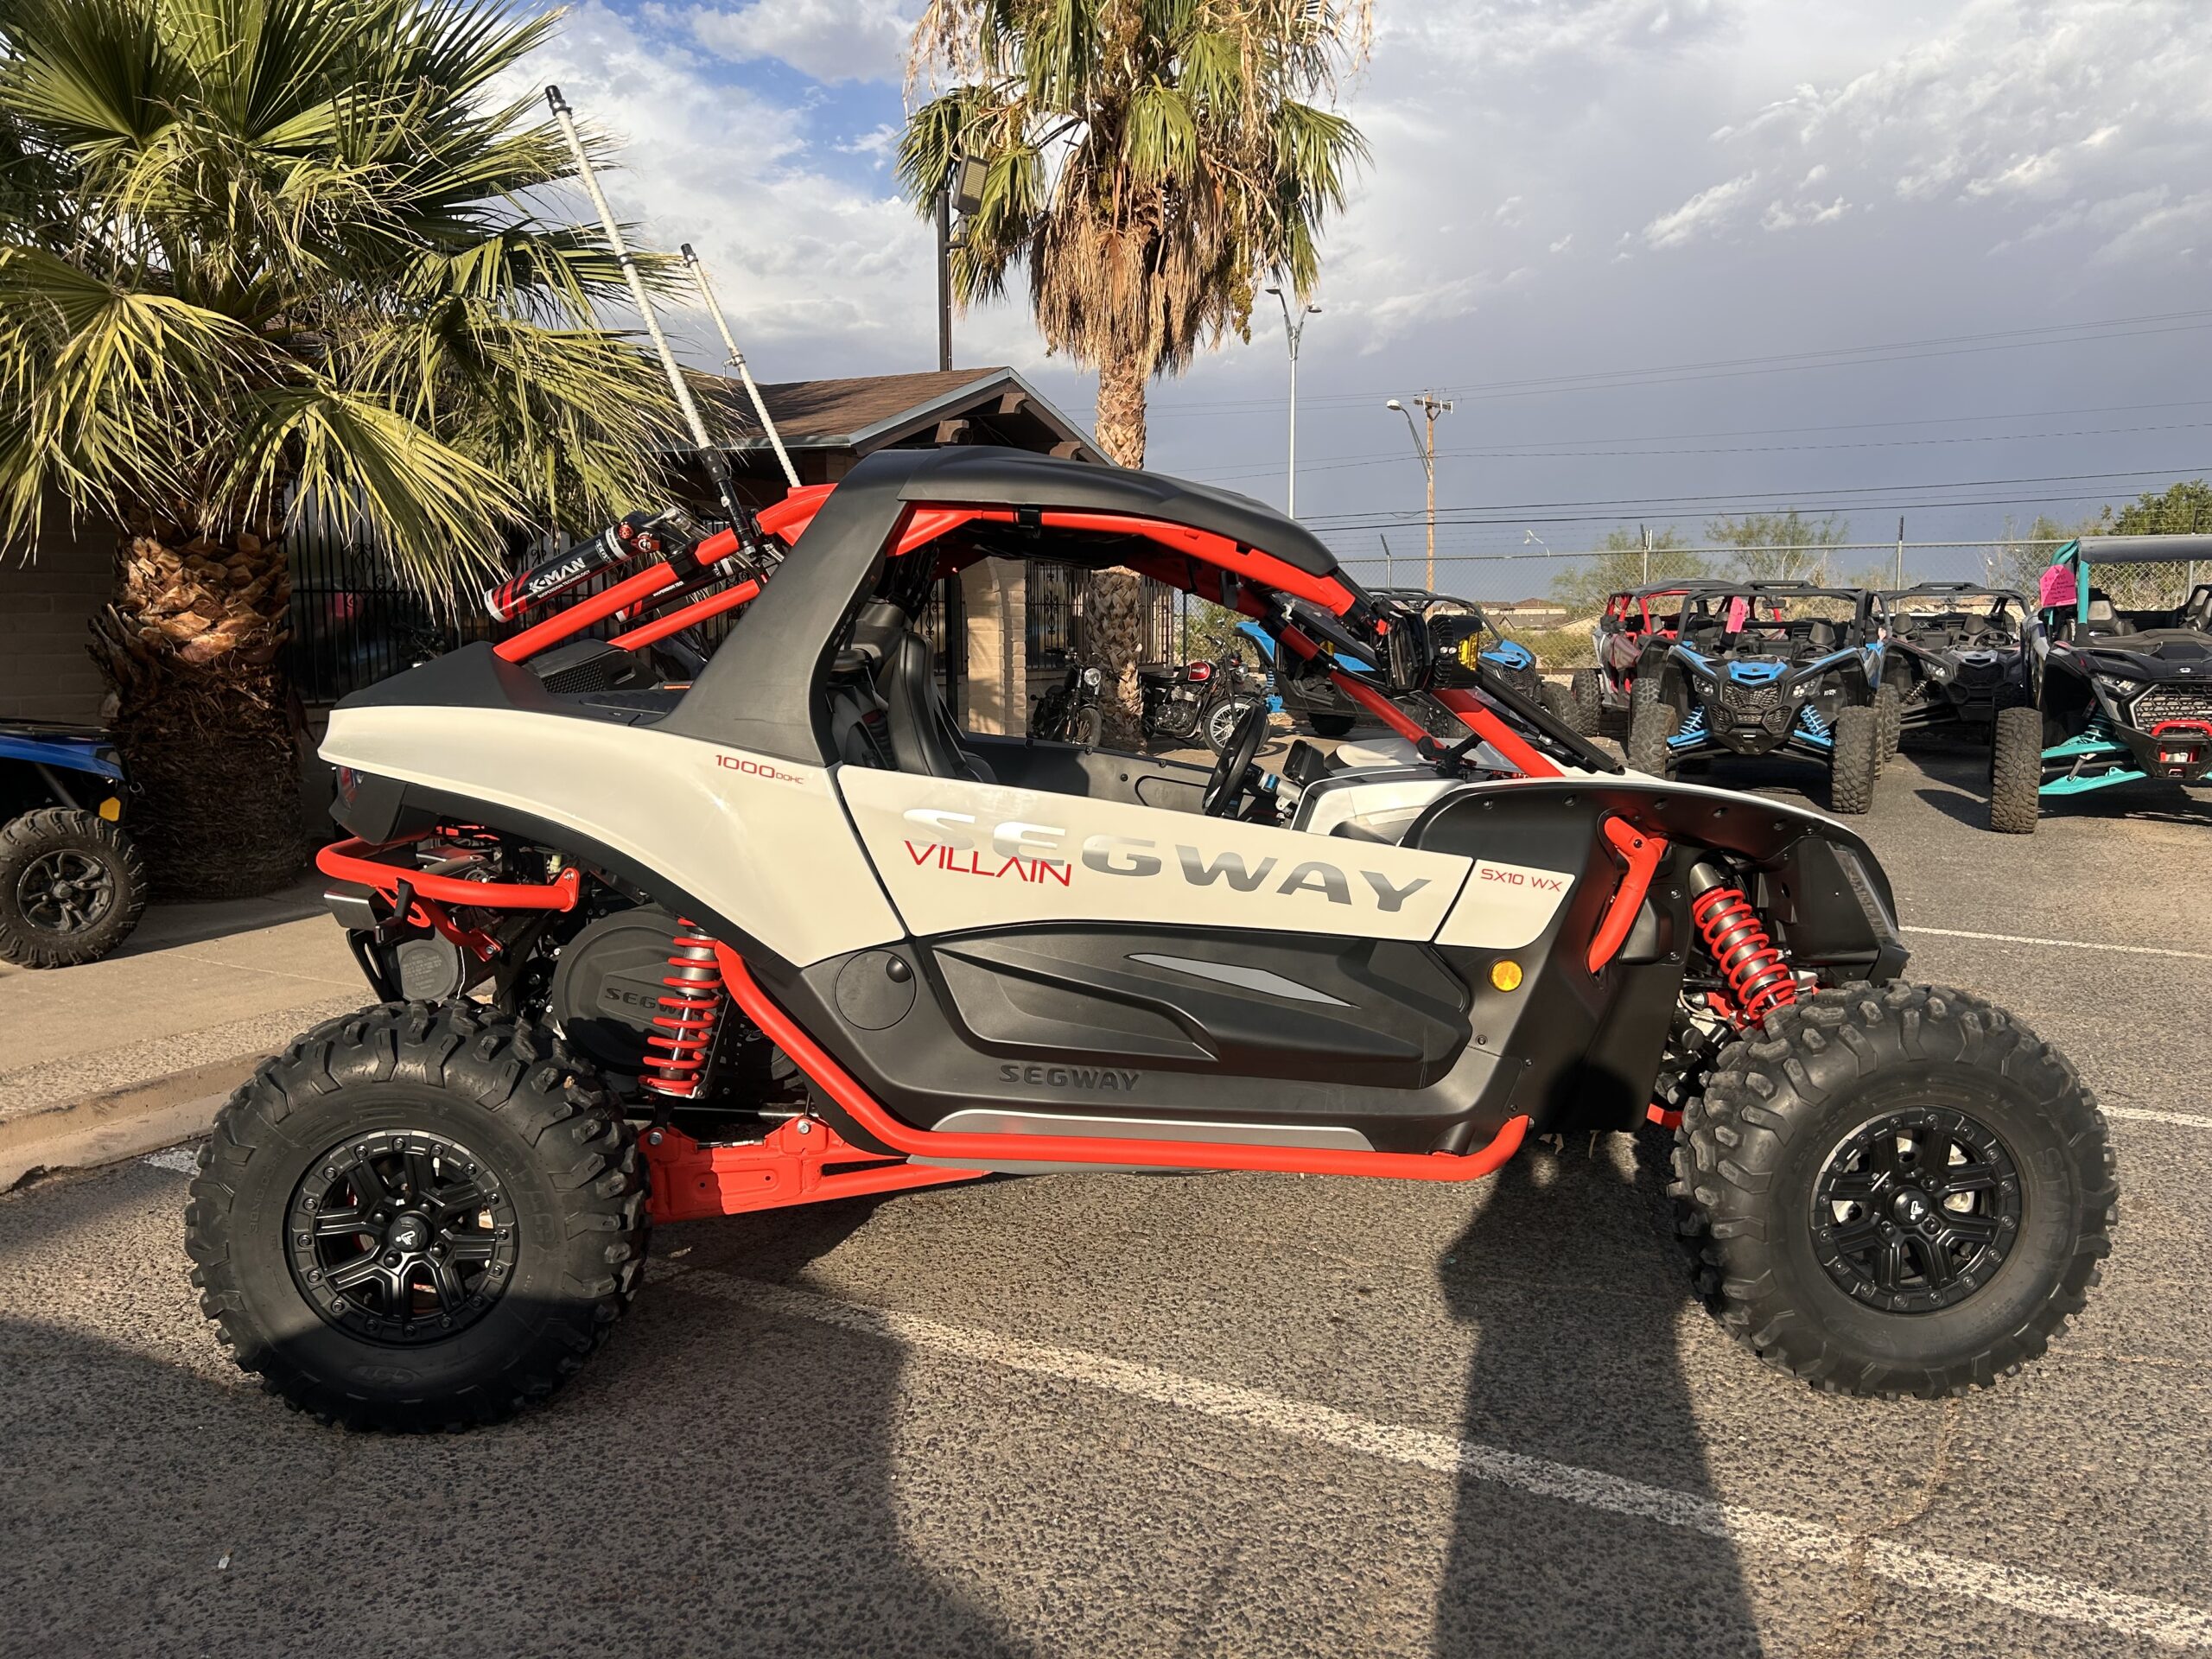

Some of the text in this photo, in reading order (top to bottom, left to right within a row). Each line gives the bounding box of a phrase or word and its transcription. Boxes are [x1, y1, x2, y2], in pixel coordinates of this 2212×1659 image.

[903, 809, 1432, 912] SEGWAY
[905, 840, 1071, 887] VILLAIN
[1480, 868, 1562, 892] SX10 WX
[999, 1065, 1140, 1091] SEGWAY
